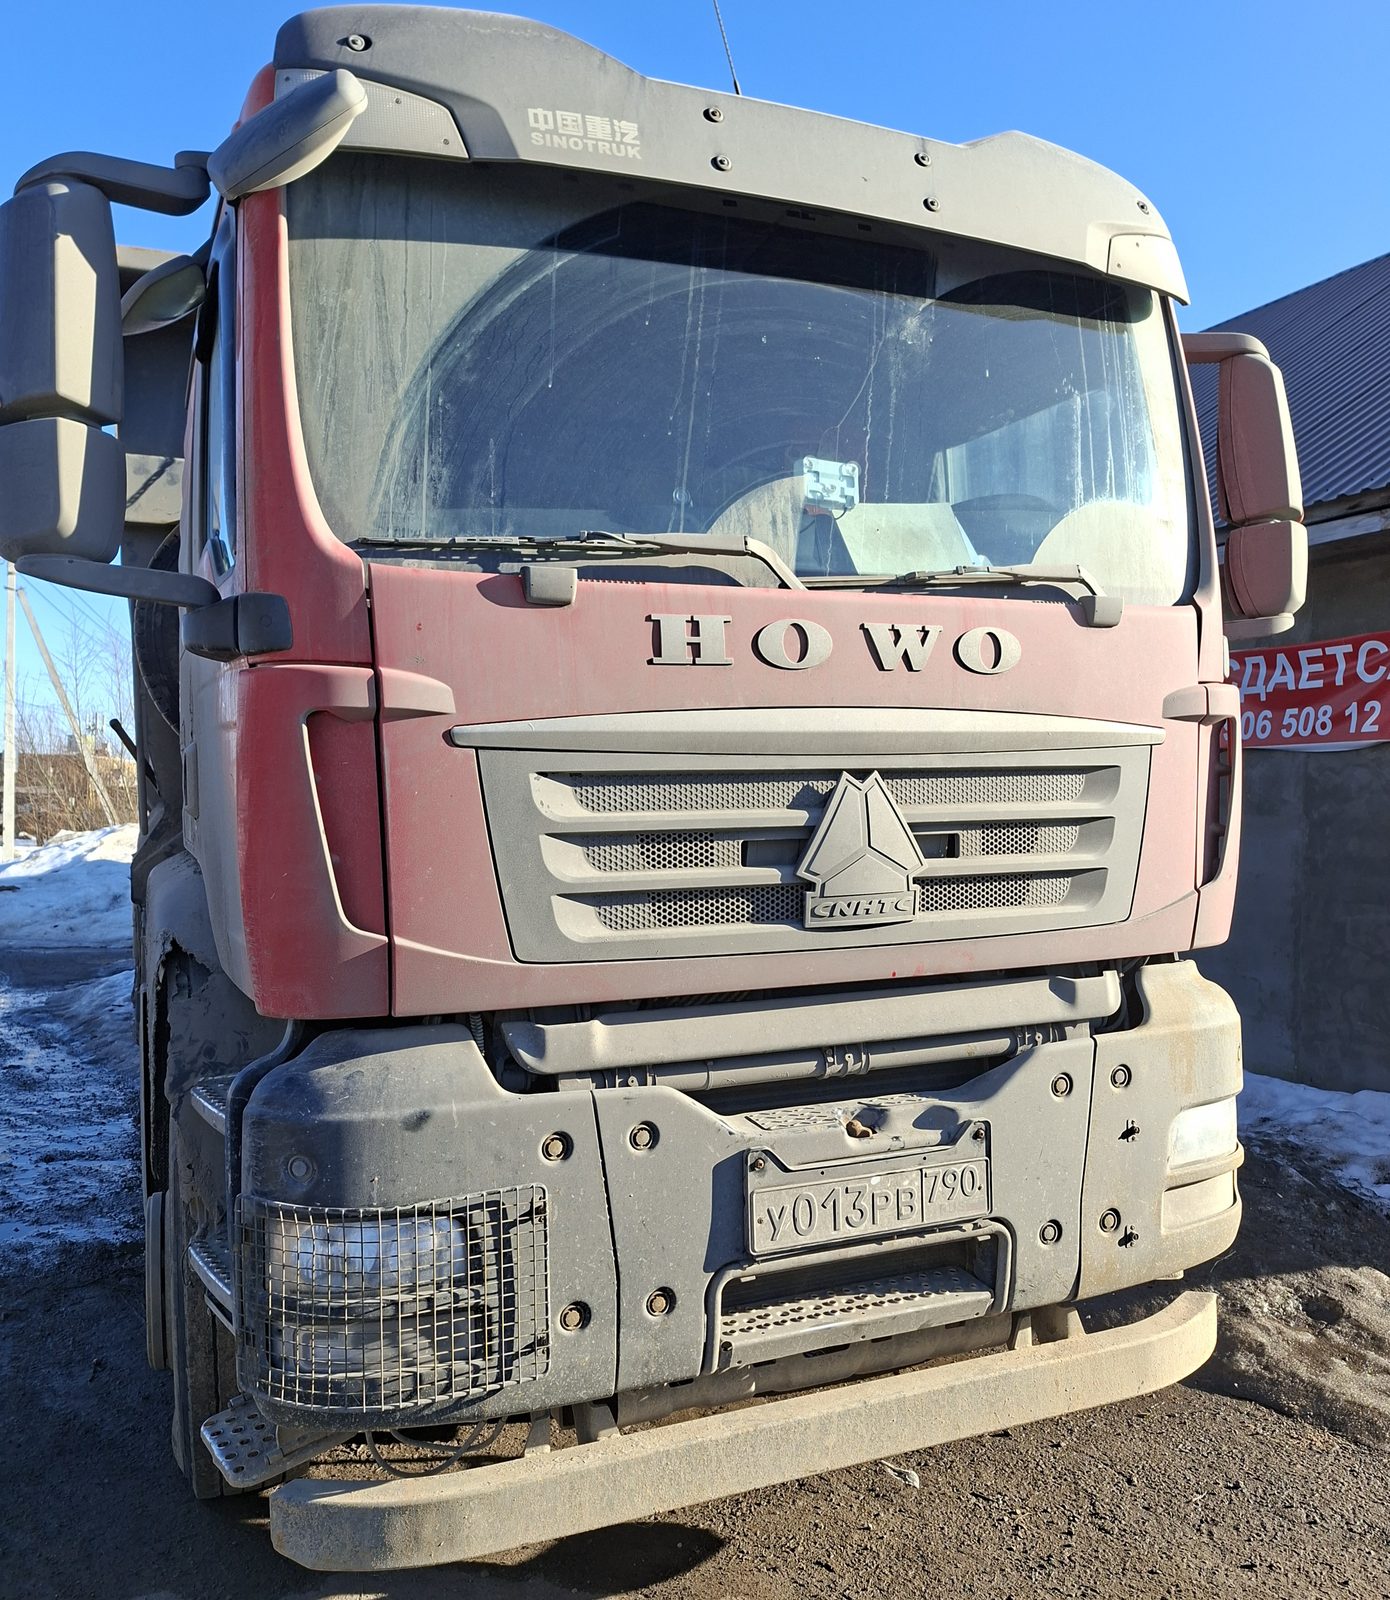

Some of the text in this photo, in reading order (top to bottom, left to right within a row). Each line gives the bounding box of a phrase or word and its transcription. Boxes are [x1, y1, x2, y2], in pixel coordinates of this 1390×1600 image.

[527, 107, 641, 145] 中国重汽
[530, 131, 642, 160] SINOTRUK
[645, 613, 1022, 675] HOWO
[1223, 700, 1382, 741] 06 508 12
[811, 898, 912, 919] CNHTC
[924, 1164, 979, 1203] 790
